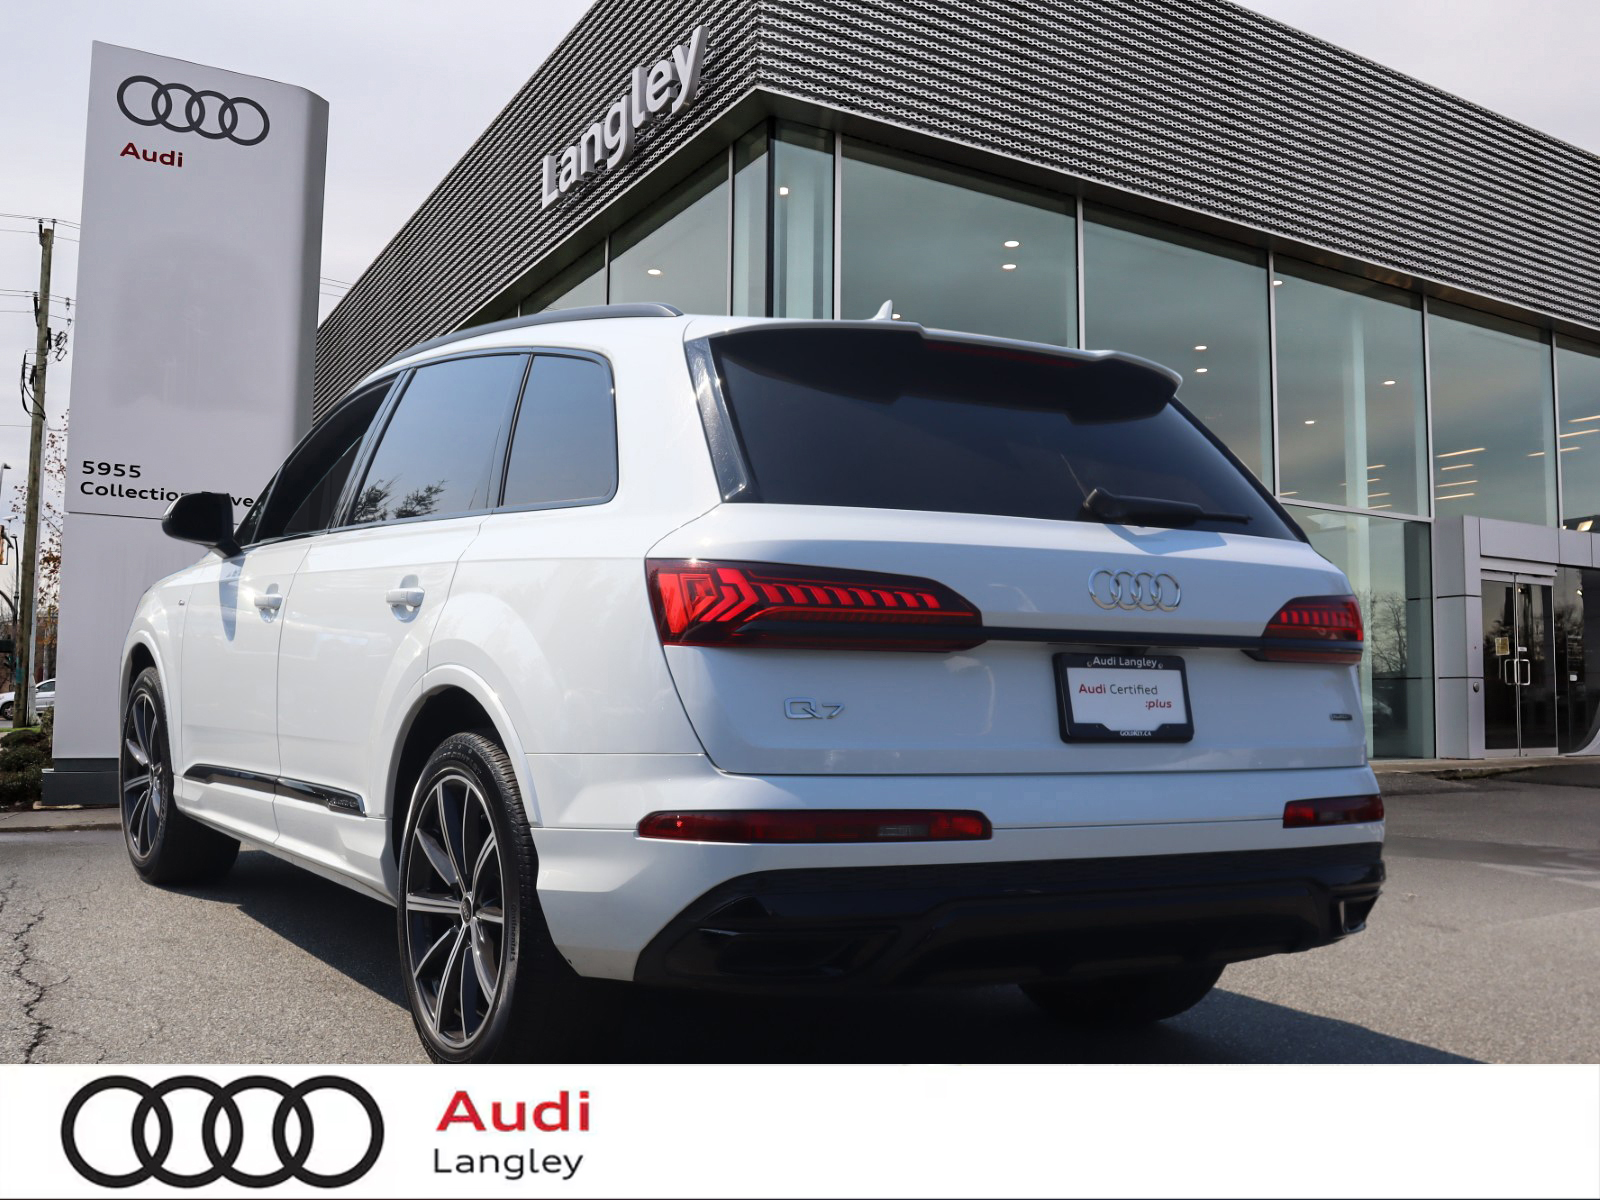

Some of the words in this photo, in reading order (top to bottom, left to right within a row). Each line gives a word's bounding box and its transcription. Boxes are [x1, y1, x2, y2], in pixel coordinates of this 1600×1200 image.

[541, 25, 709, 209] Langley
[120, 142, 183, 167] Audi
[82, 460, 141, 478] 5955
[1093, 656, 1116, 666] Audi
[1119, 657, 1157, 668] Langley
[1079, 684, 1106, 694] Audi
[1110, 684, 1158, 695] Certified
[784, 697, 845, 719] Q7
